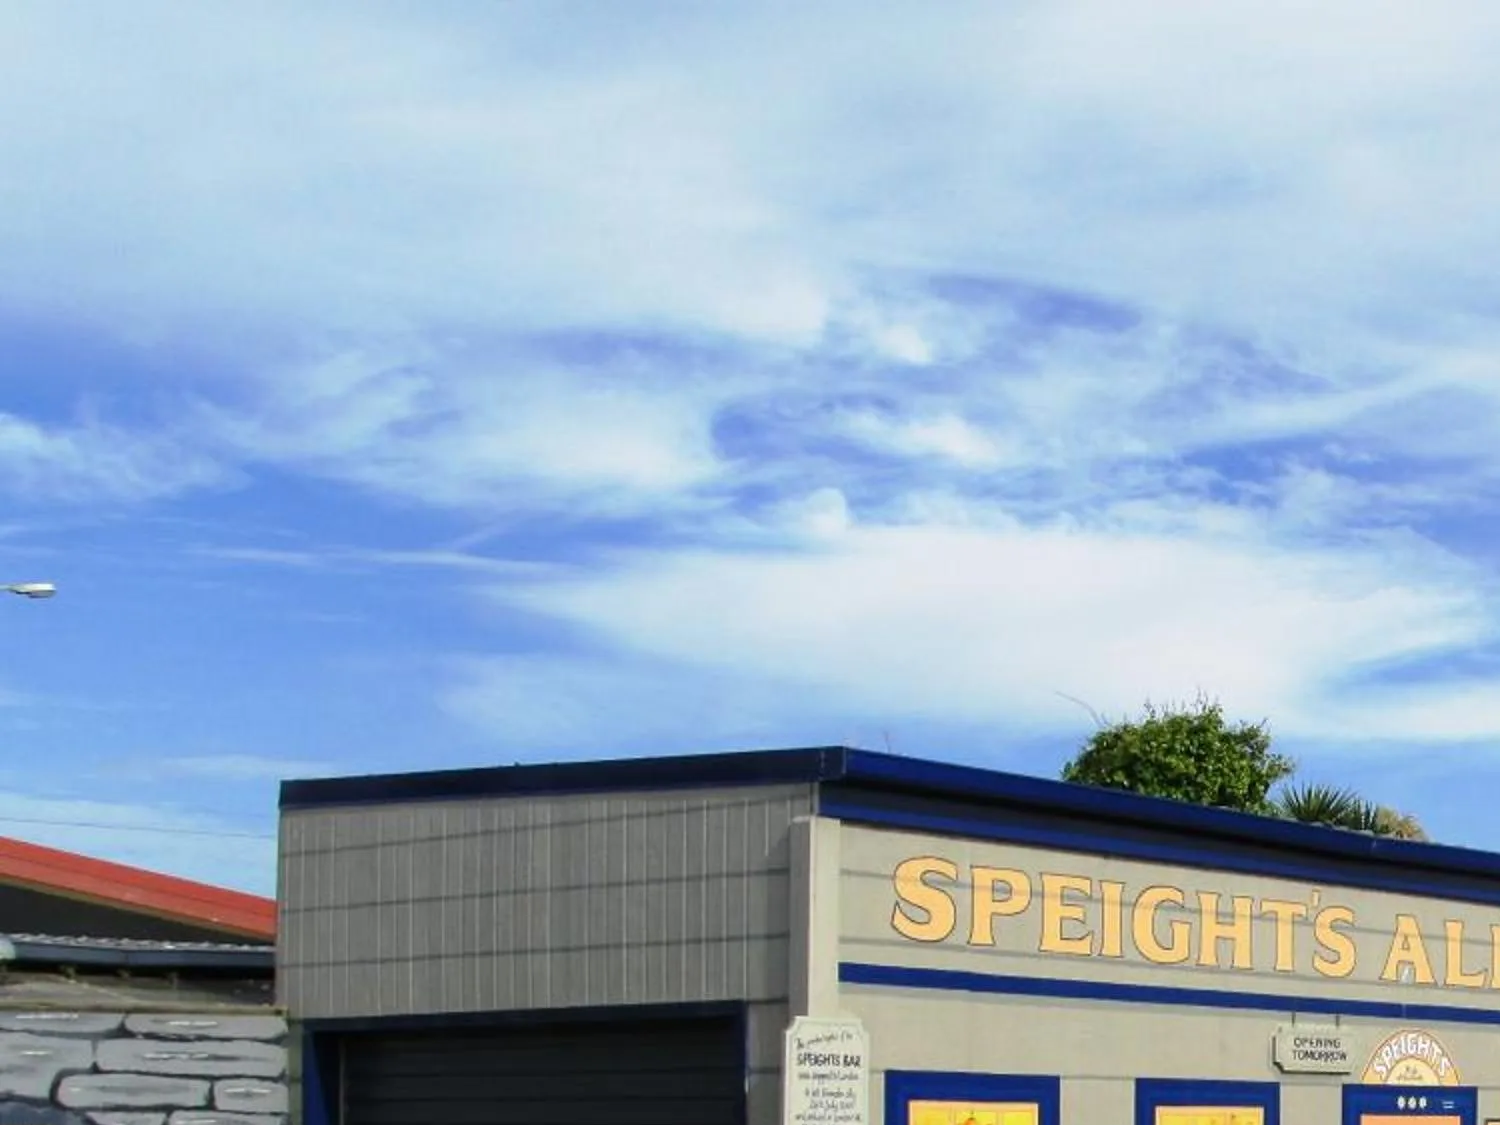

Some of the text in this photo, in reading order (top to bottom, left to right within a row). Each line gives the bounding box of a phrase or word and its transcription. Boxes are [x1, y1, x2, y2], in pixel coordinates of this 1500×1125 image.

[889, 855, 1358, 978] SPEIGHT'S
[1293, 1036, 1341, 1049] OPENING
[1292, 1049, 1347, 1063] TOMORROW
